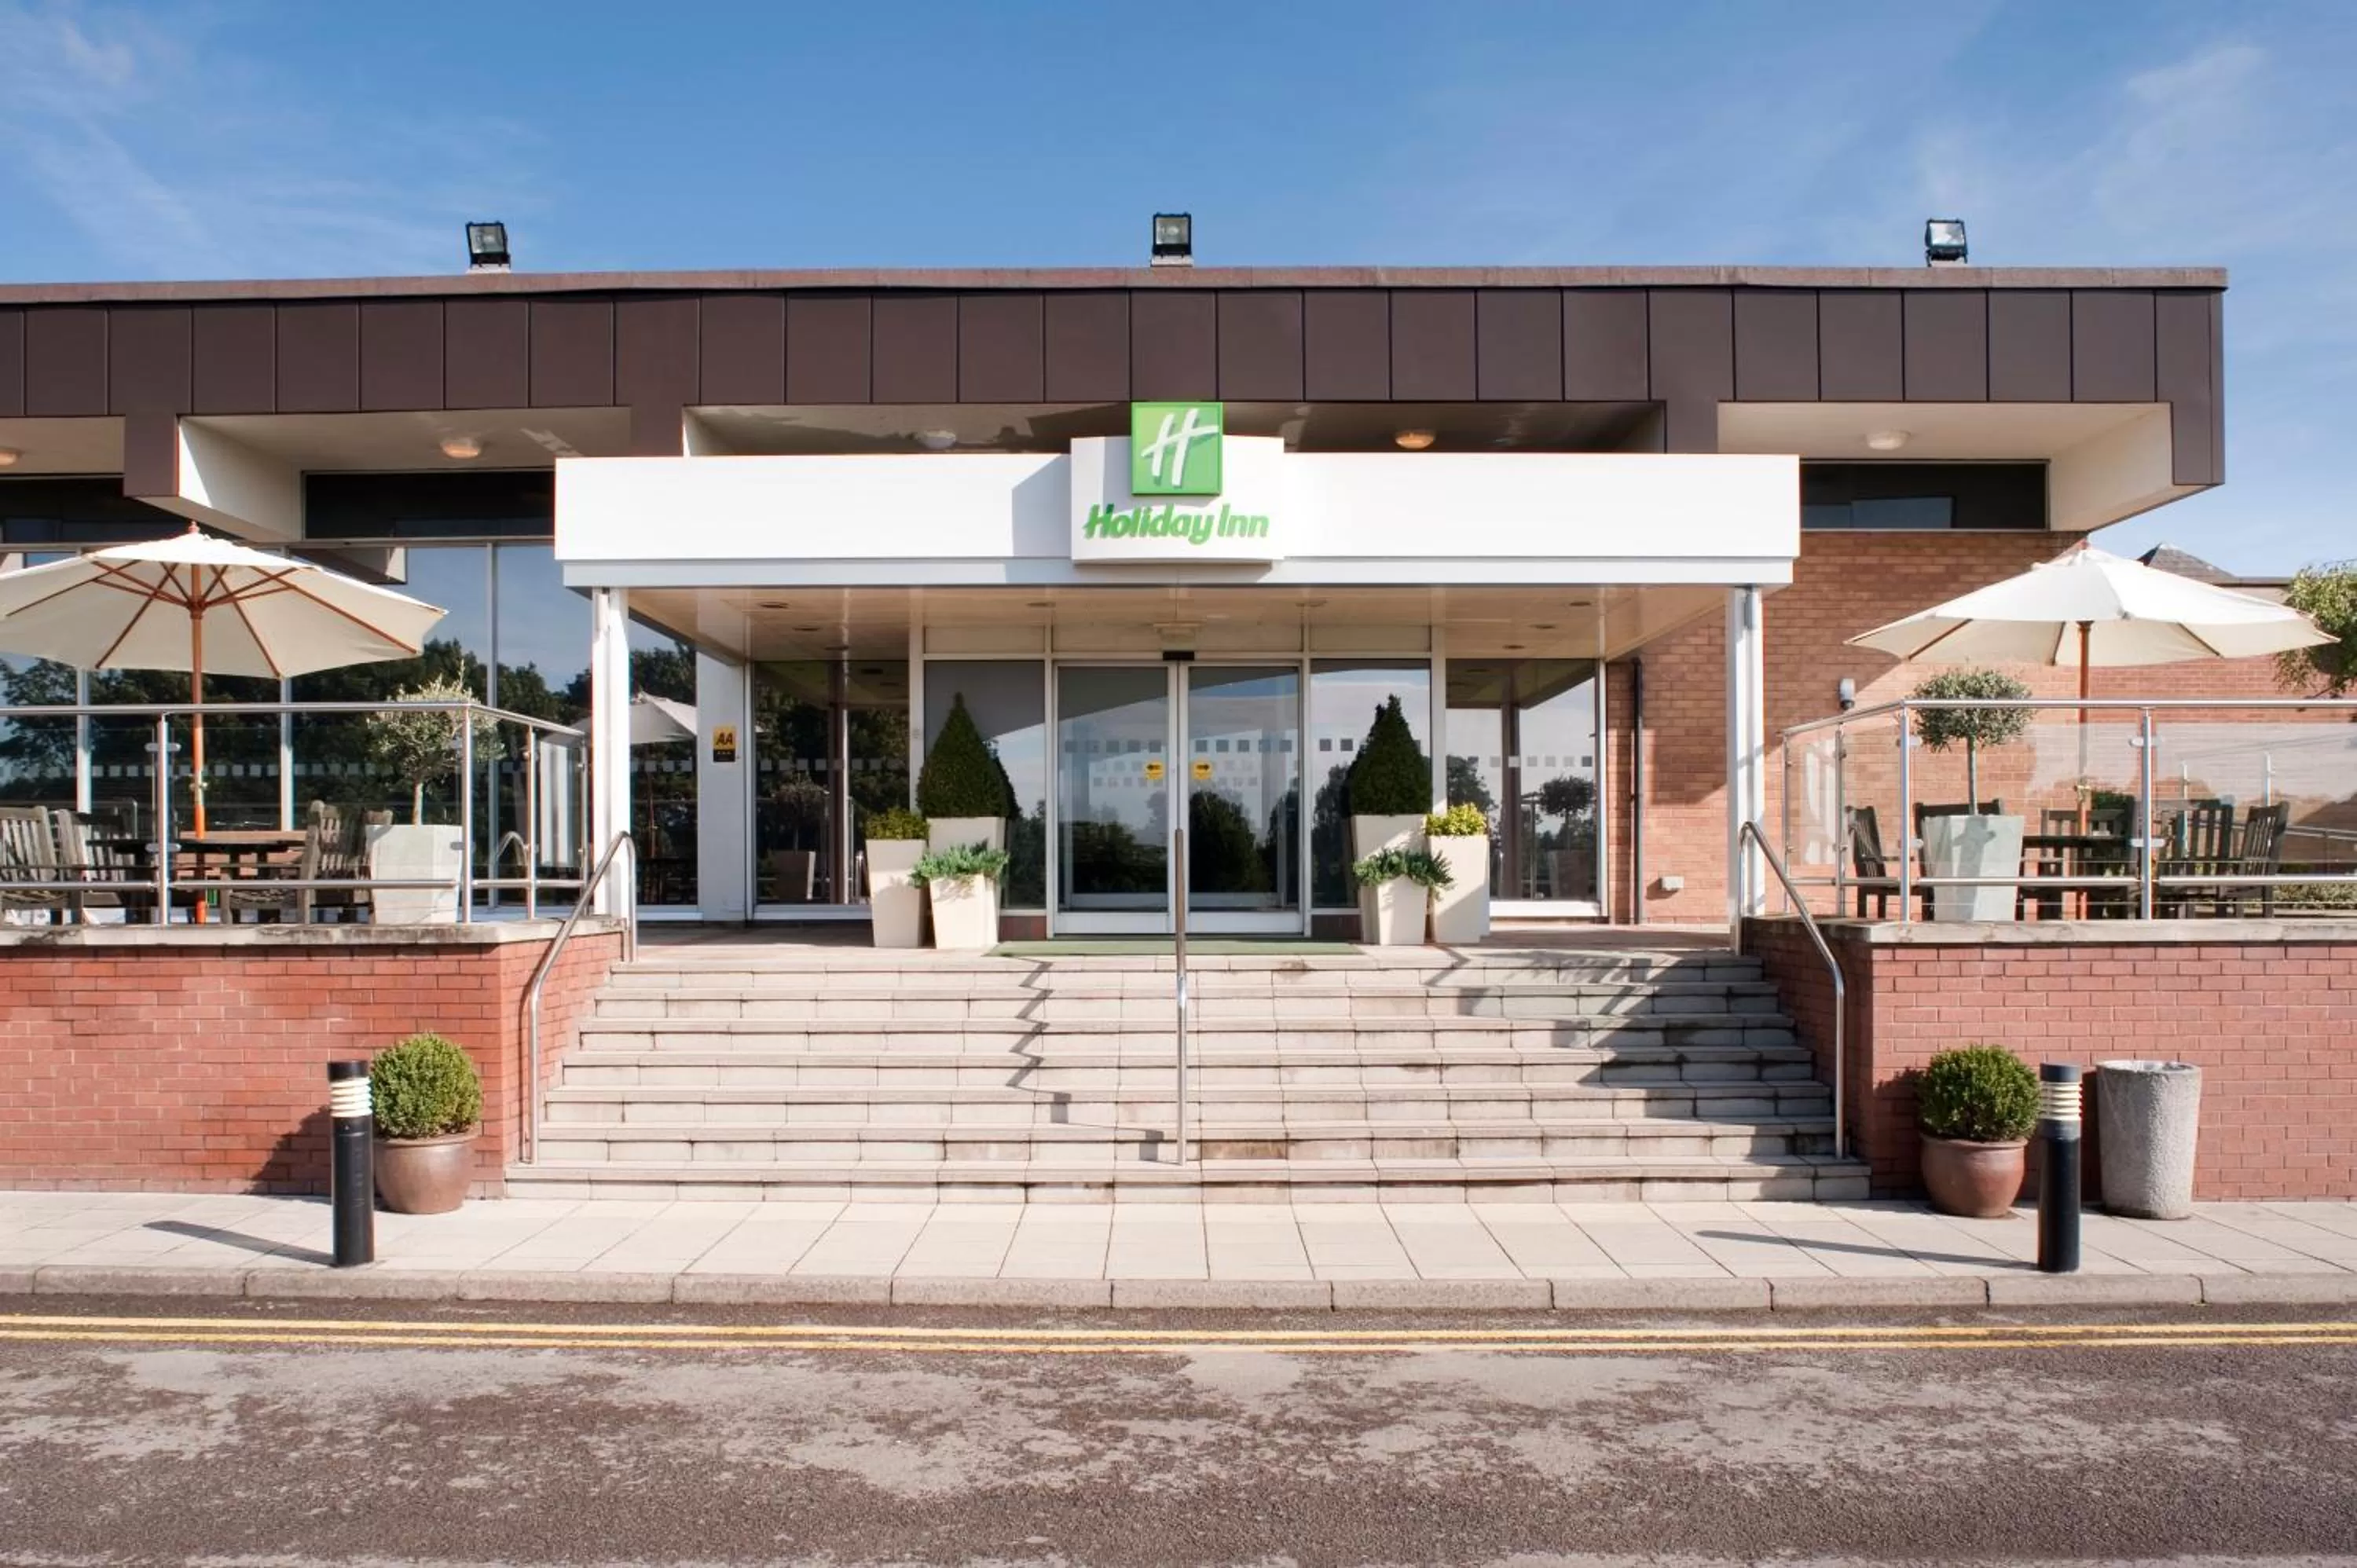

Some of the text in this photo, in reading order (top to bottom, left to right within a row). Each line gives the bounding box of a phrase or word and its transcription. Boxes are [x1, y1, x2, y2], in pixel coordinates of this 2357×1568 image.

[1083, 503, 1270, 545] Holiday Inn
[716, 731, 734, 746] AA
